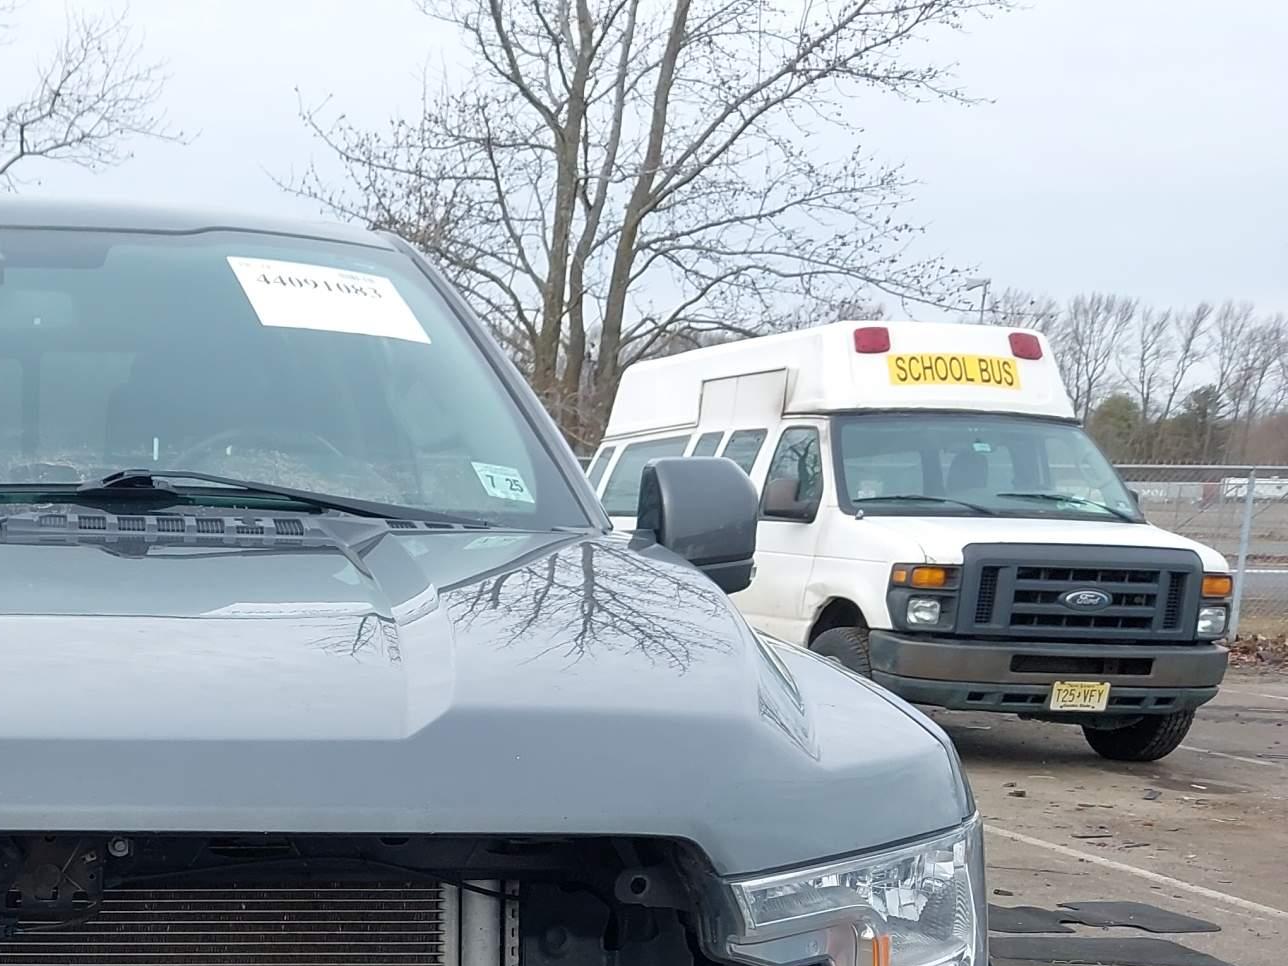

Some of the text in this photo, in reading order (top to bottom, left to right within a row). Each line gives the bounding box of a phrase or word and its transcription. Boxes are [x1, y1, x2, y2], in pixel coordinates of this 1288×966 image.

[256, 273, 383, 299] 44091083
[895, 356, 1014, 386] SCHOOL BUS
[505, 478, 524, 493] 25
